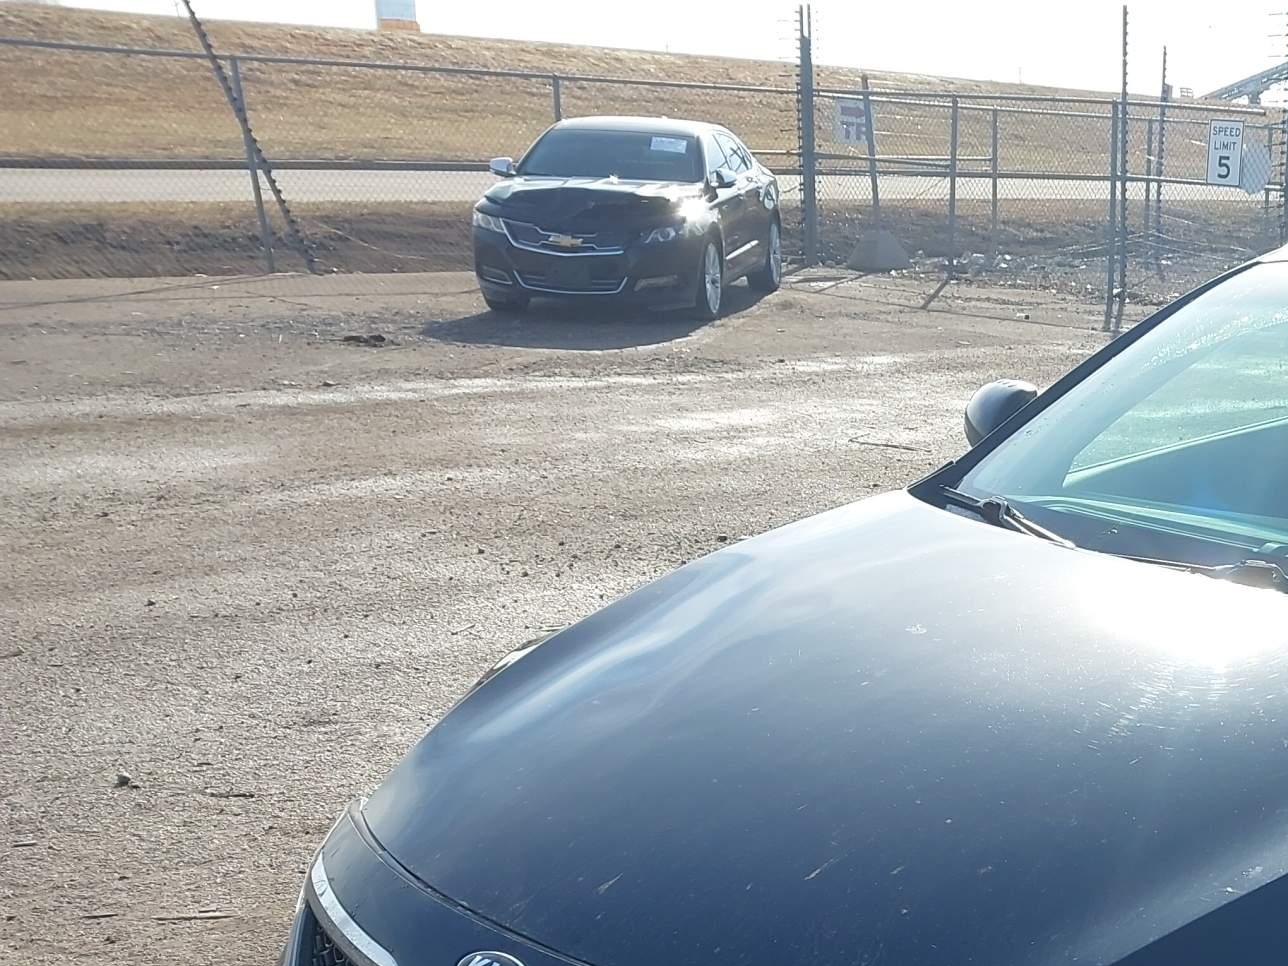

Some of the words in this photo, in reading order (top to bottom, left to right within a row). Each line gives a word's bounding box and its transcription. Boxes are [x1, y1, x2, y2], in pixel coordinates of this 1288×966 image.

[1212, 126, 1241, 137] SPEED
[1213, 141, 1237, 151] LIMIT
[1217, 155, 1231, 179] 5
